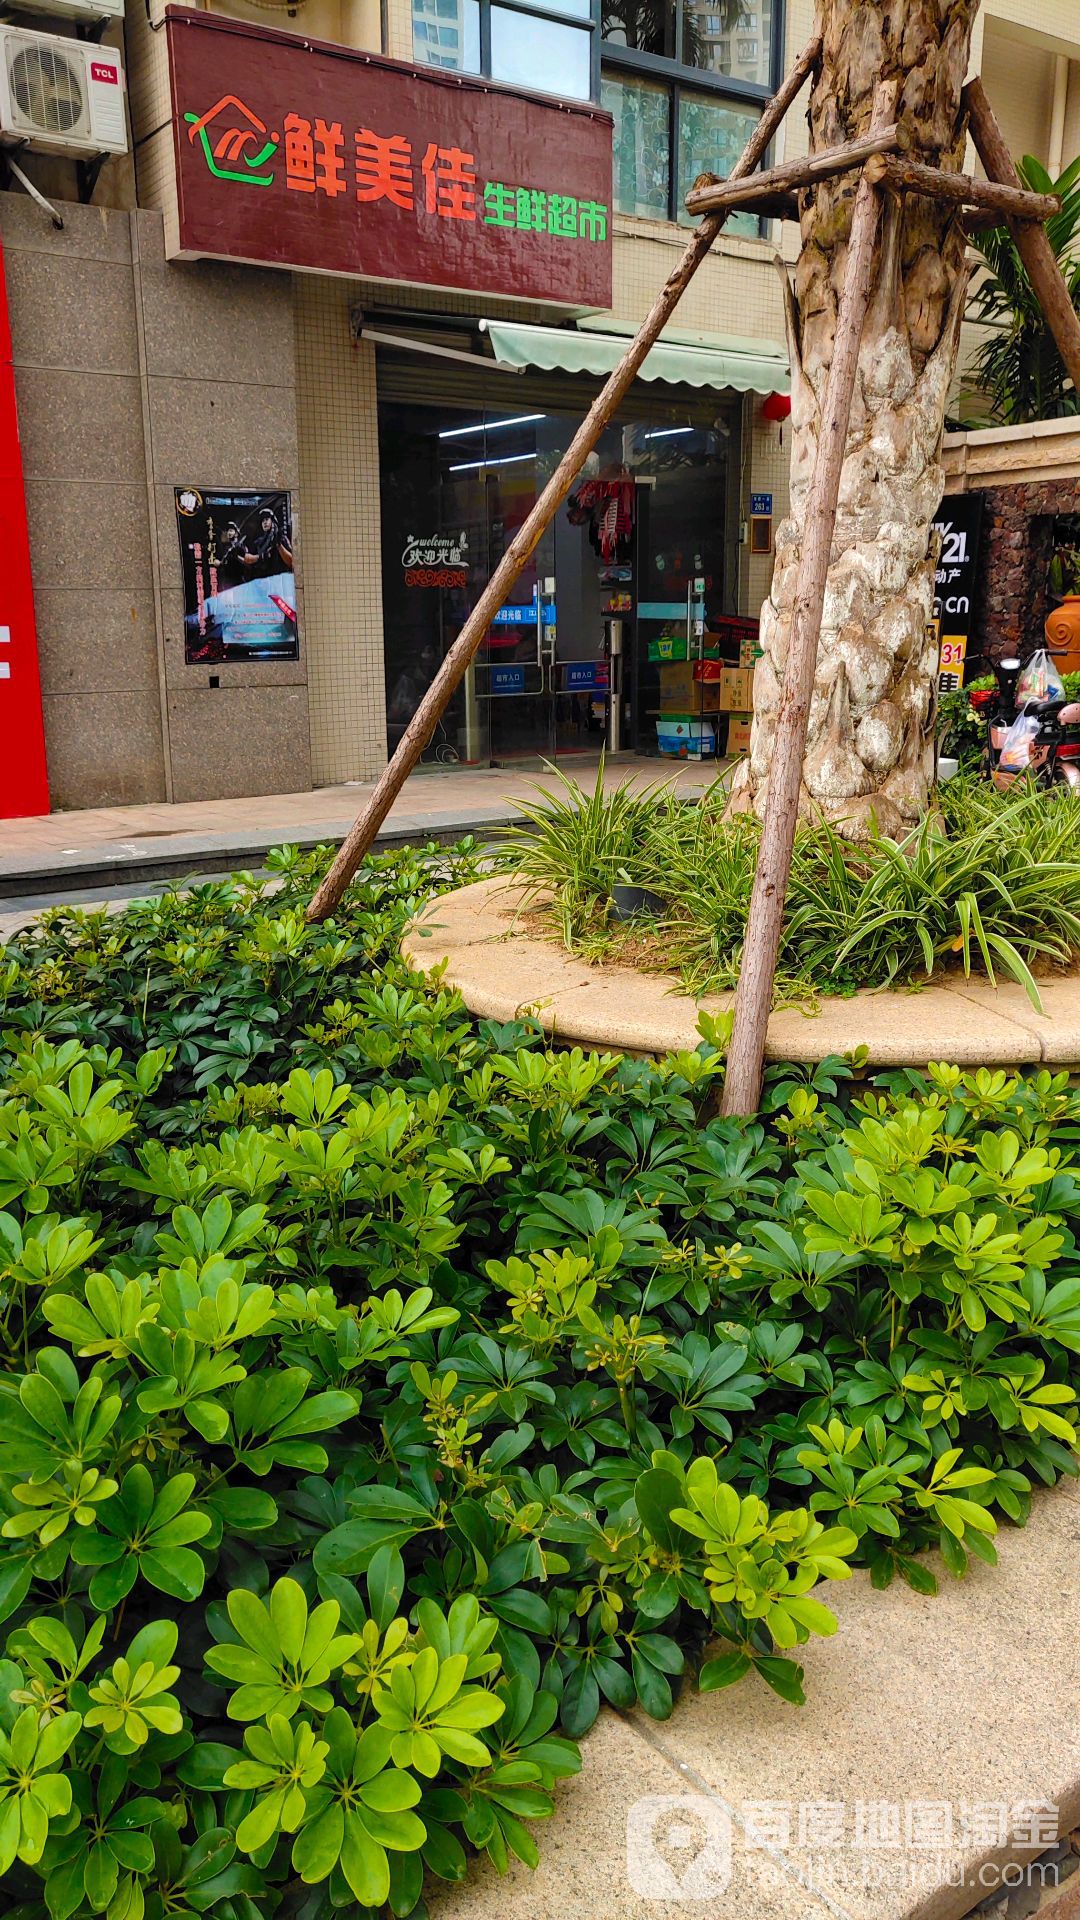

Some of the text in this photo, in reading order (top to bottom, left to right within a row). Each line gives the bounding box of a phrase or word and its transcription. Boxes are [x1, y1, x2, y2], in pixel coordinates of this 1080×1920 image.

[95, 68, 114, 79] TCL
[285, 112, 477, 221] 鲜美佳
[483, 181, 608, 242] 生鲜超市
[419, 534, 455, 547] welcome
[403, 547, 468, 567] 欢迎光临
